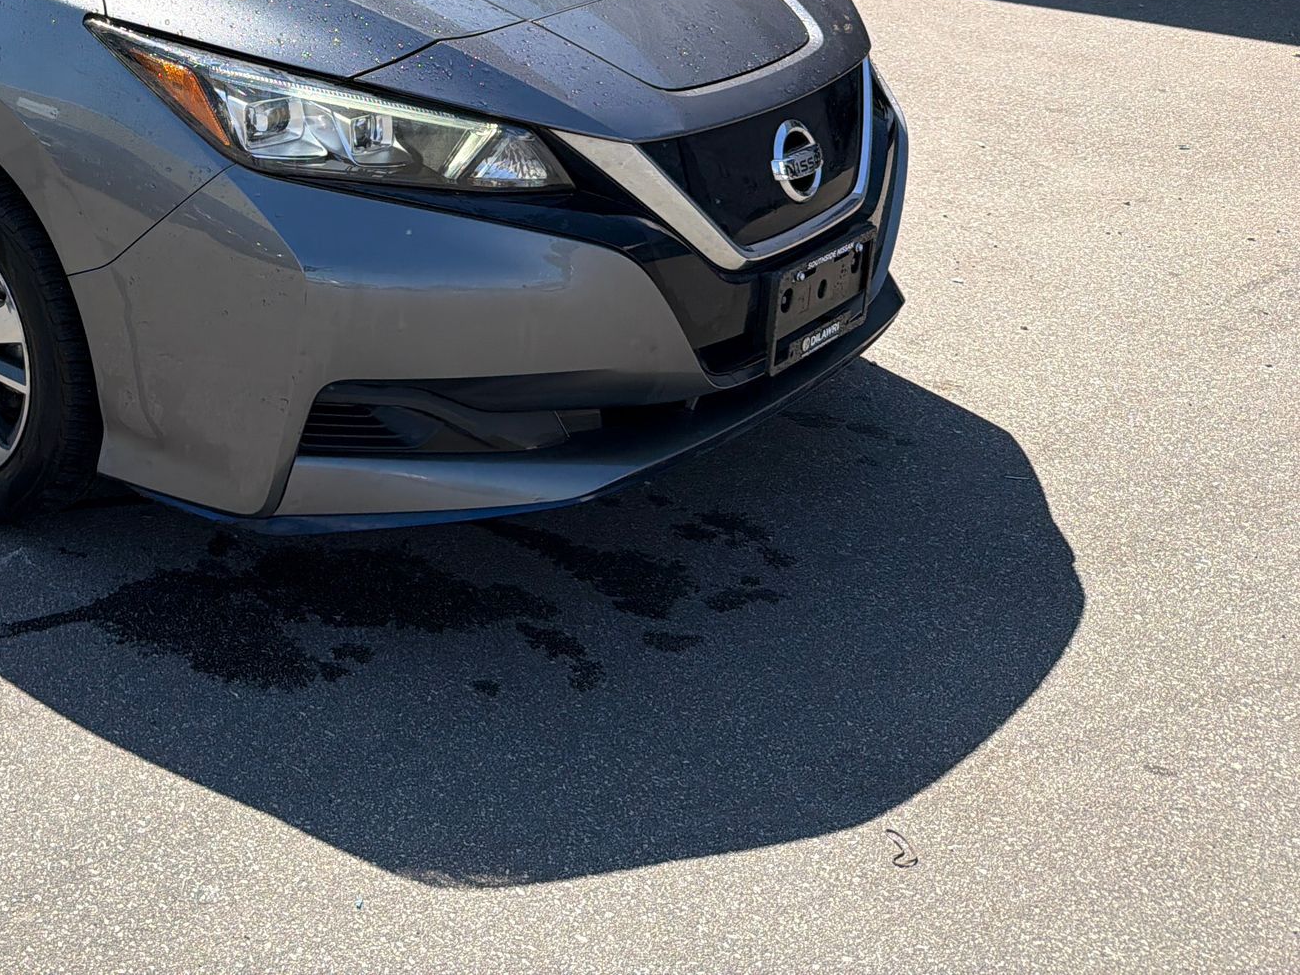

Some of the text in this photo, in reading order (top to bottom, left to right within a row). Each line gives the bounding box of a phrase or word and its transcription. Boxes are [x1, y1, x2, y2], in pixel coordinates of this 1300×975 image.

[807, 241, 855, 270] SOUTHSIDE NISSAN
[811, 321, 840, 346] DILAWRI
